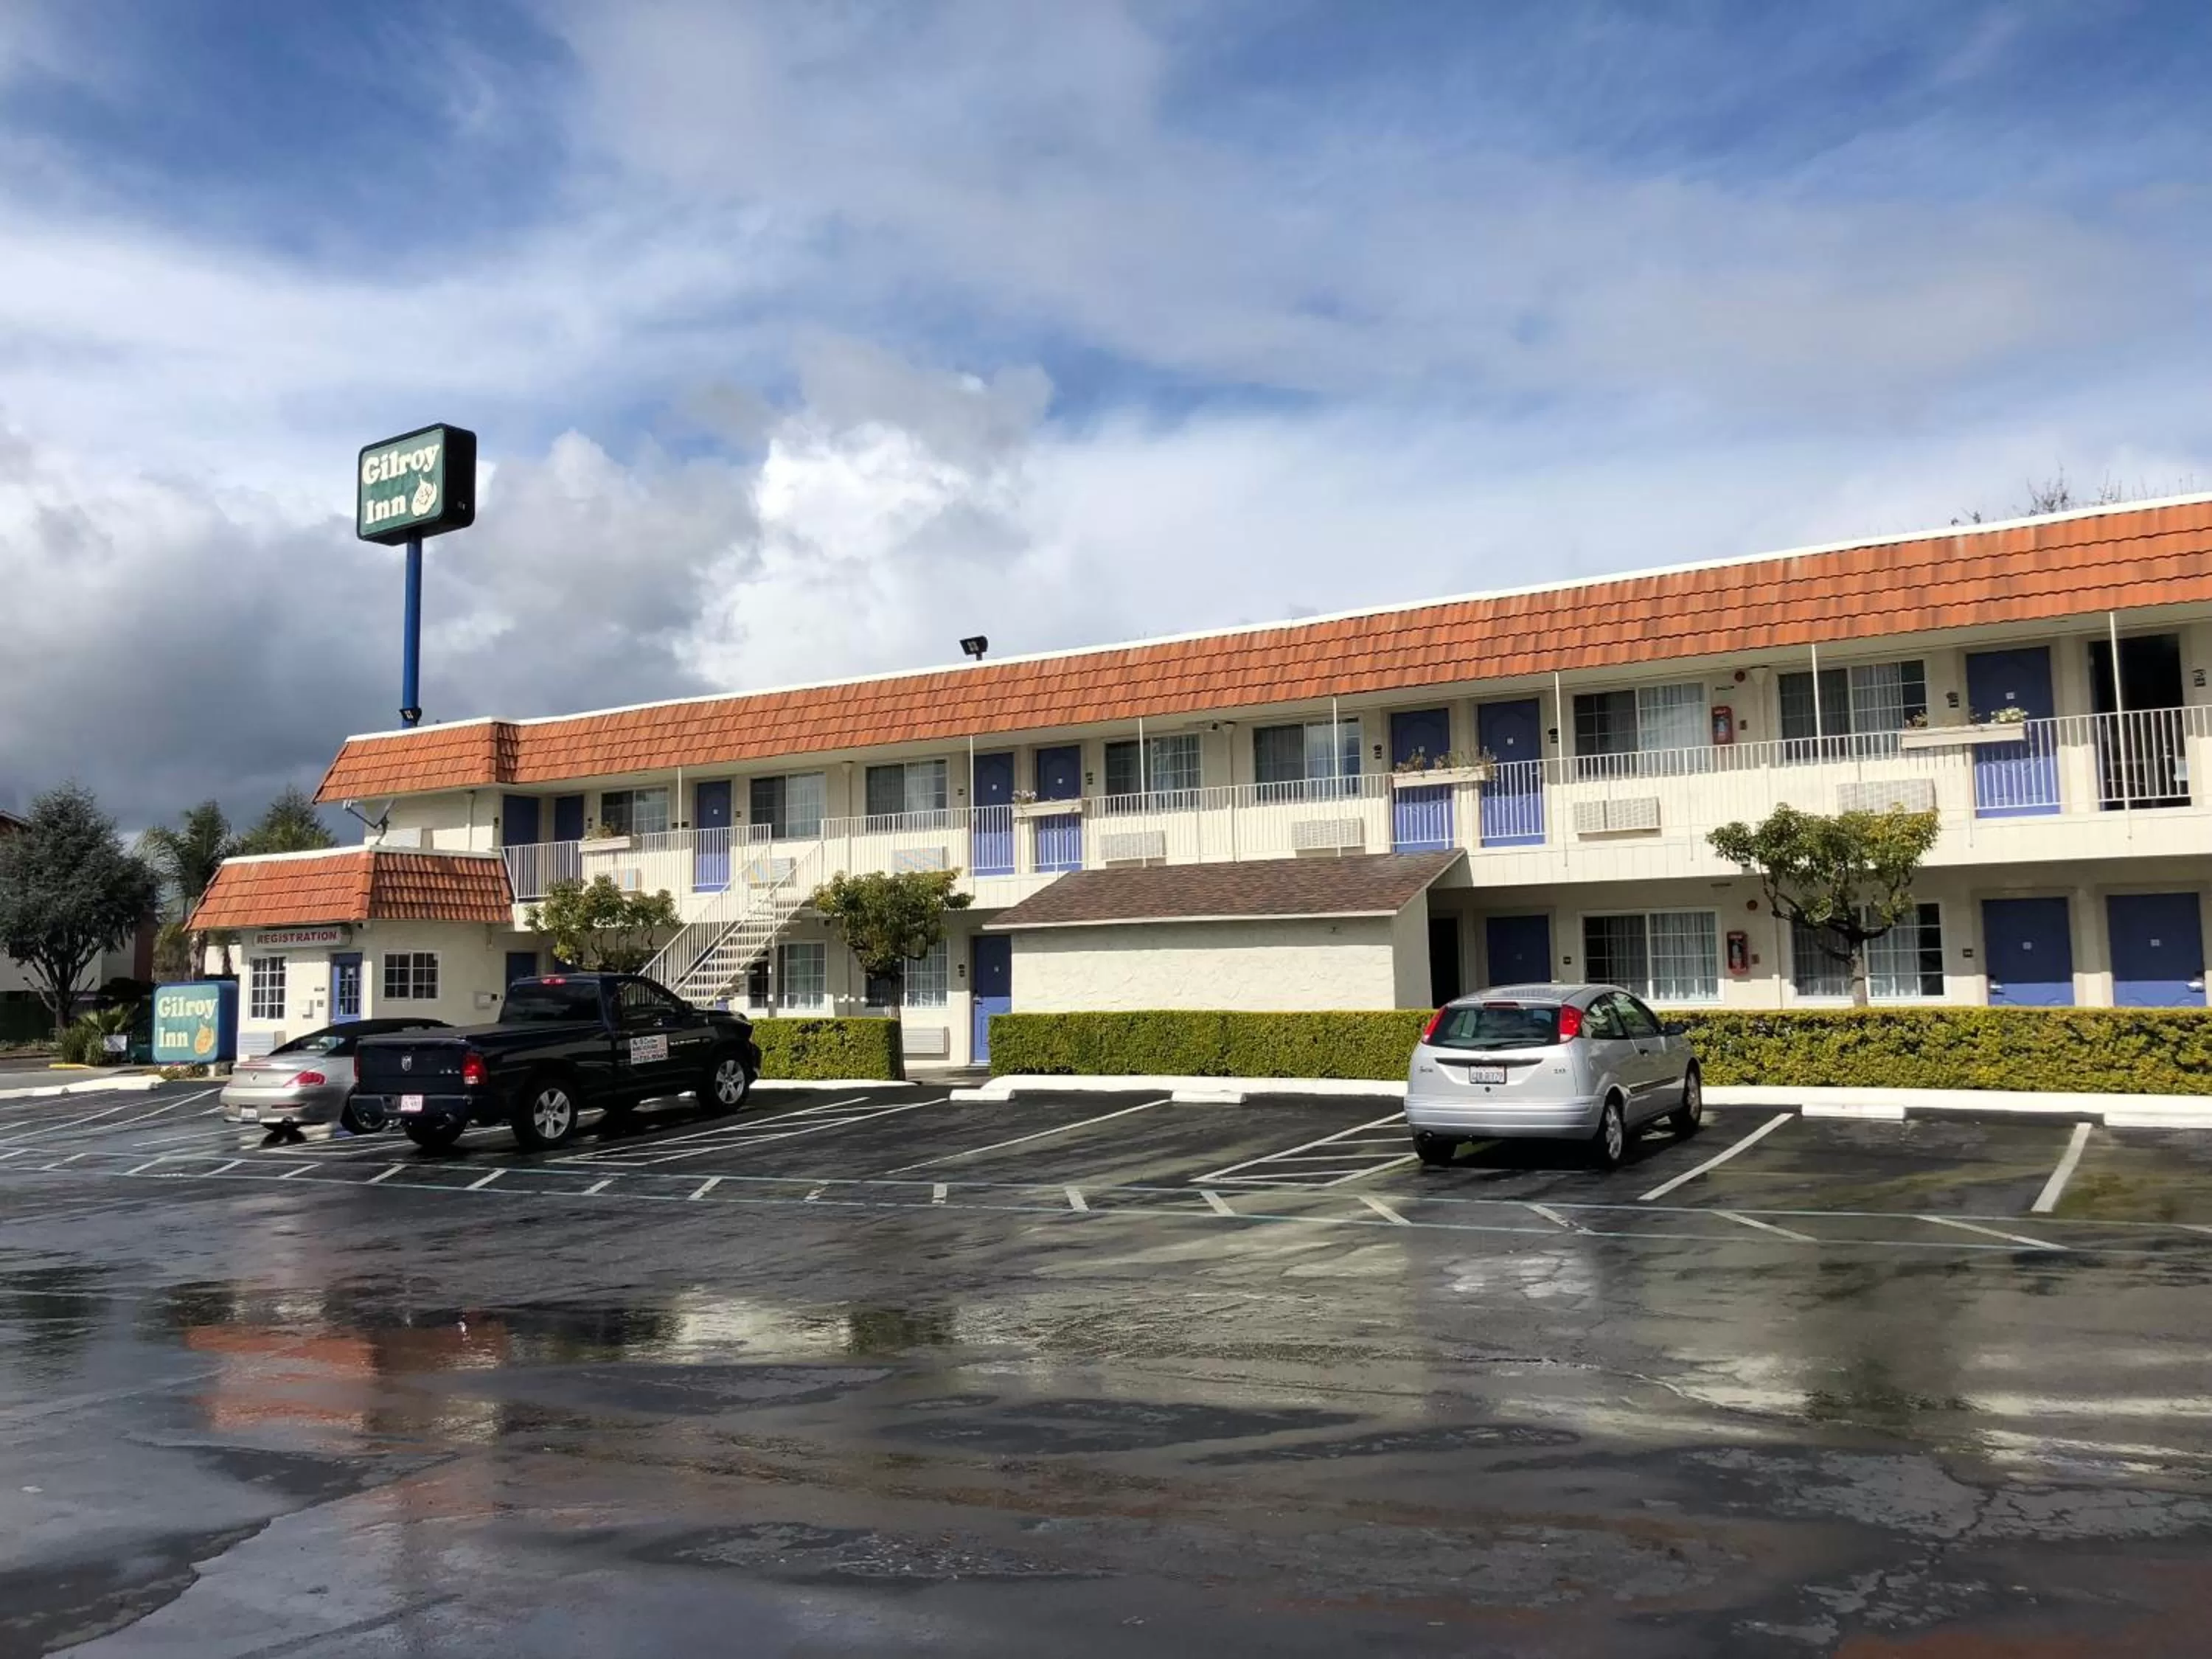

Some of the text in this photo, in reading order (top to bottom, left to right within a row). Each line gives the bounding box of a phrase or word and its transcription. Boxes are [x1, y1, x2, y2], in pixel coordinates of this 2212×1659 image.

[362, 443, 440, 484] Gilroy
[365, 494, 407, 524] Inn
[257, 931, 338, 945] REGISTRATION
[157, 995, 218, 1020] Gilroy
[158, 1026, 189, 1048] Inn
